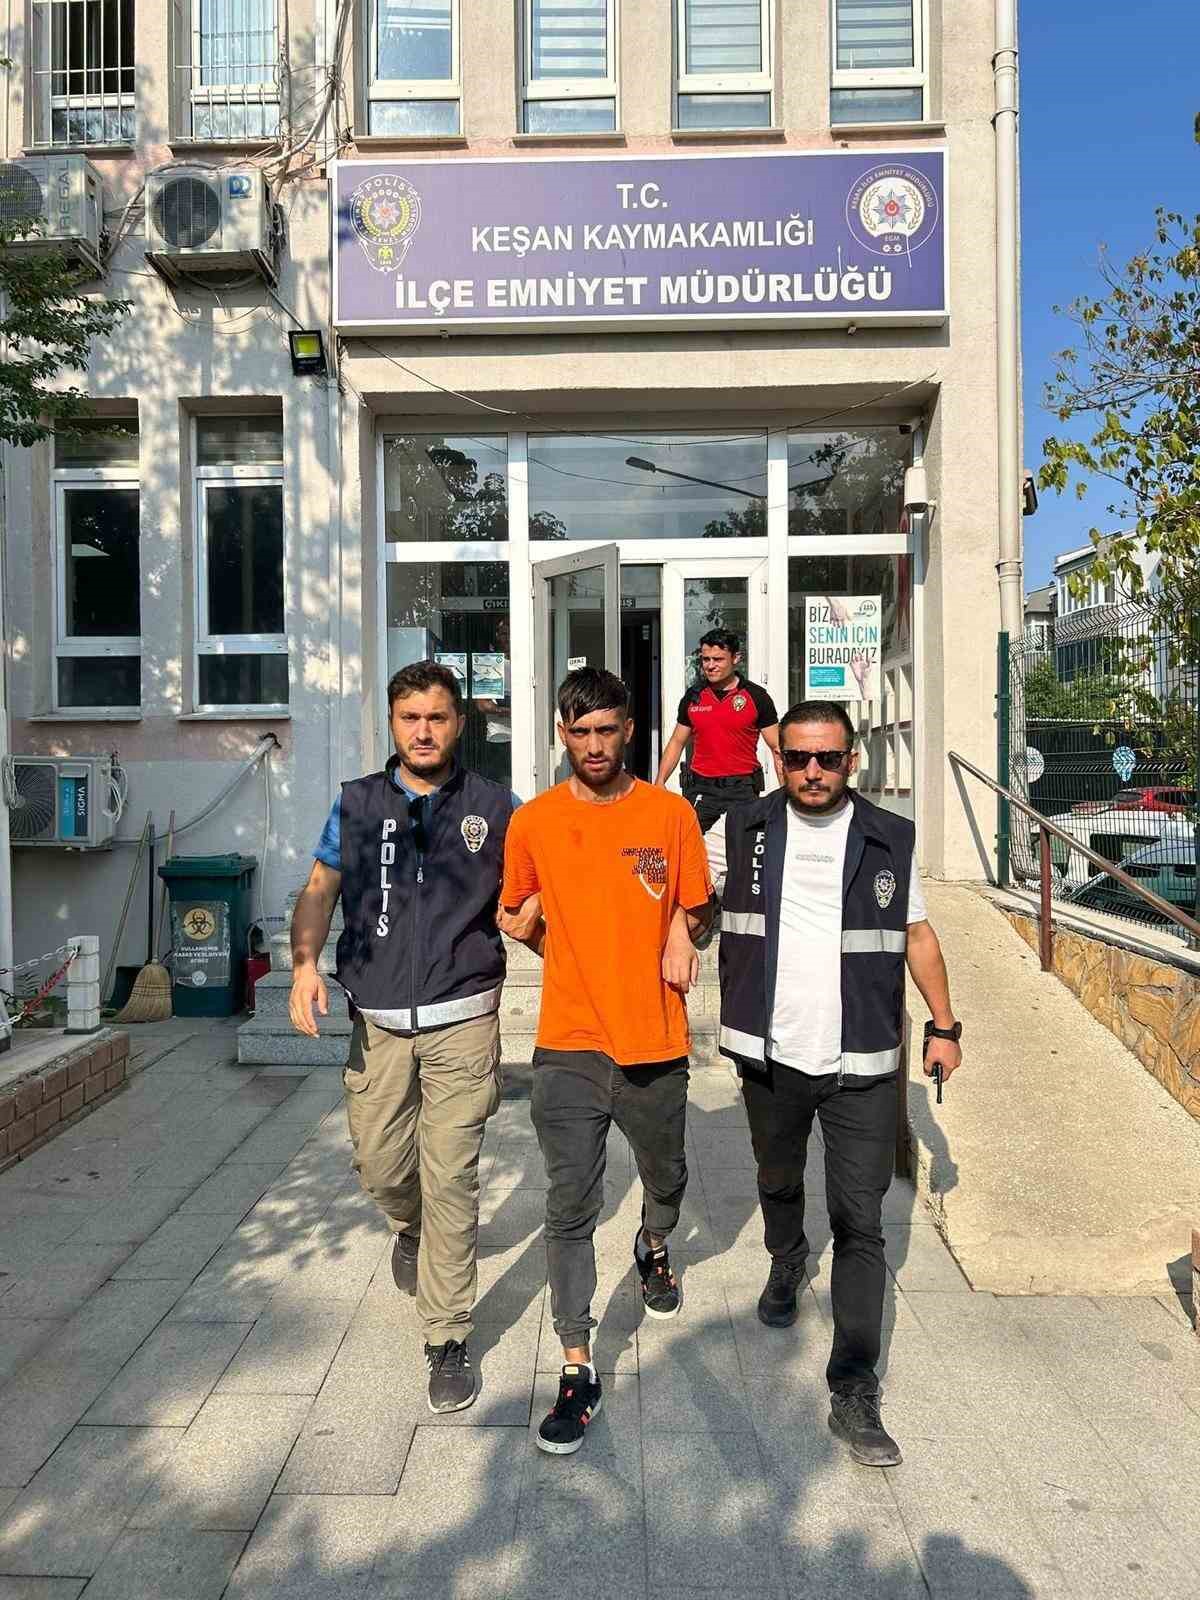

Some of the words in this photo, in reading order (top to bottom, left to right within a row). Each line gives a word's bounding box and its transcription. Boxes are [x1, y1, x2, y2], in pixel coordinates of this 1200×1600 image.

[616, 183, 668, 209] T.C.
[471, 225, 573, 257] KEŞAN
[583, 212, 815, 250] KAYMAKAMLIĞI
[395, 273, 475, 316] İLÇE
[486, 271, 648, 308] EMNİYET
[659, 265, 892, 305] MÜDÜRLÜĞÜ
[77, 786, 86, 816] SIGMA
